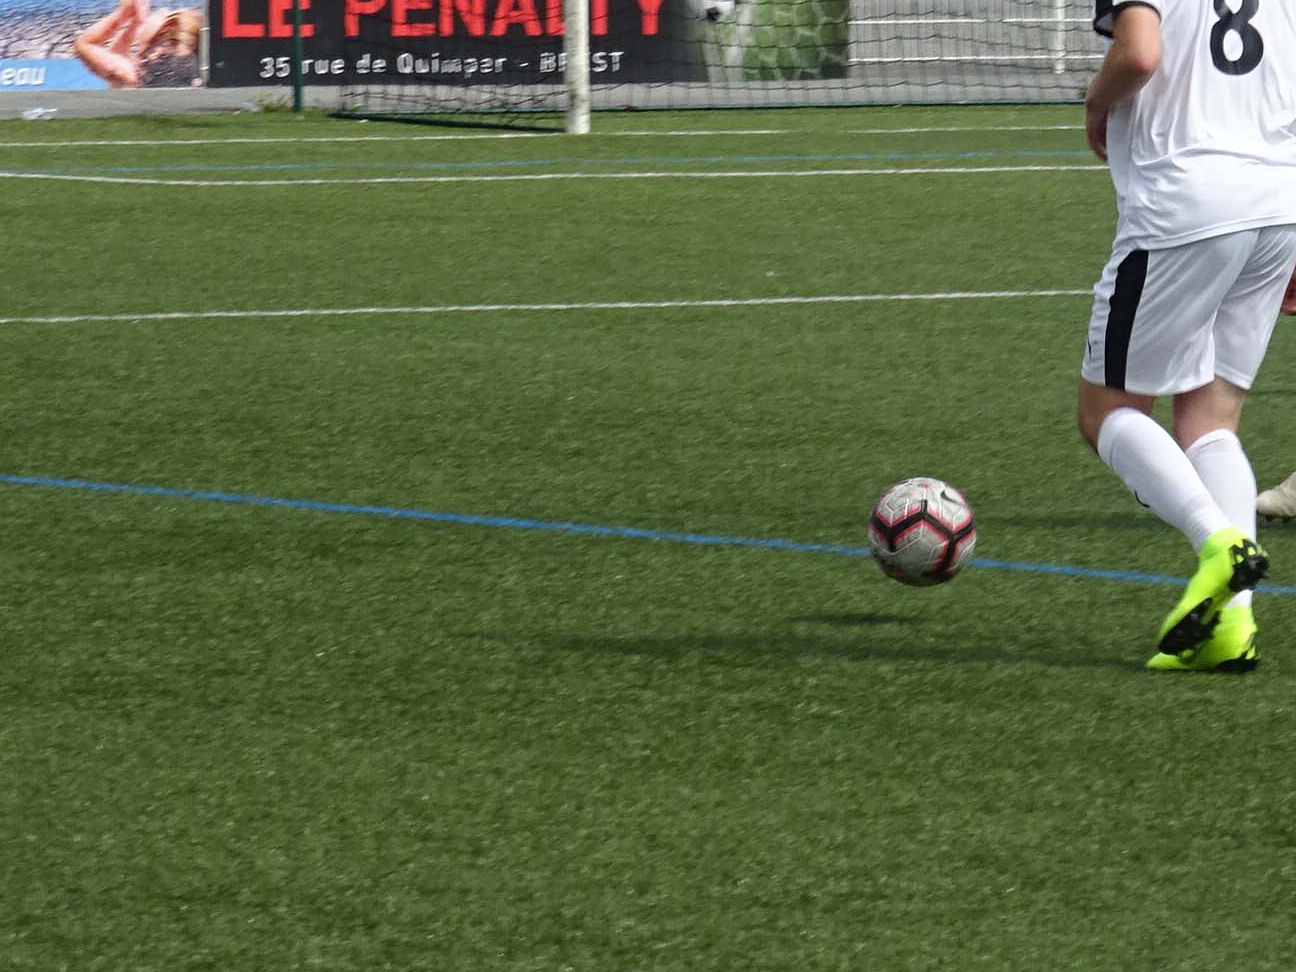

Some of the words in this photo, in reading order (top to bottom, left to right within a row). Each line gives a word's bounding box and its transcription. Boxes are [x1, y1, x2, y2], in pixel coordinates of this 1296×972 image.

[259, 56, 291, 78] 35
[301, 58, 346, 76] rue
[355, 53, 387, 74] de
[539, 51, 625, 74] BRST
